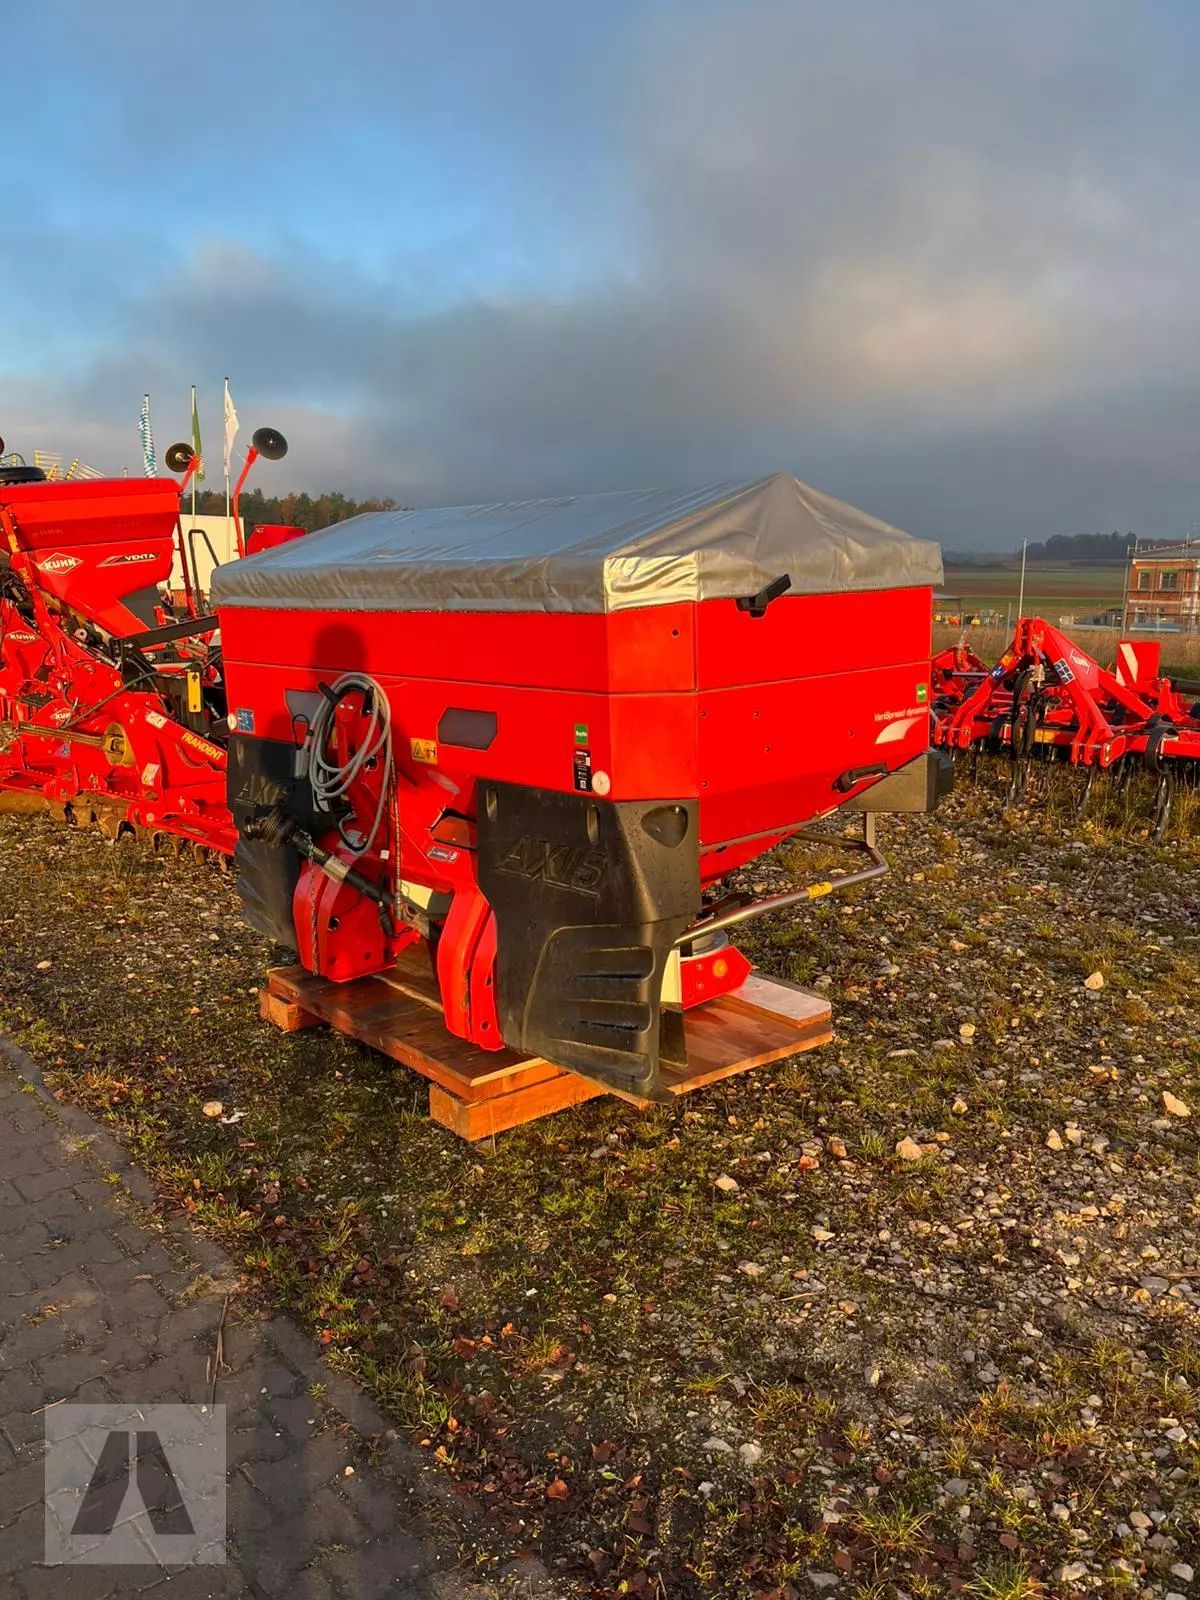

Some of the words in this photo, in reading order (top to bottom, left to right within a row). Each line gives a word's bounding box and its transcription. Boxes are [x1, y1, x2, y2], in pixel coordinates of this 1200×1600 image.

[125, 553, 156, 561] VENTA
[44, 558, 77, 571] KUHN
[495, 834, 608, 897] AXIS
